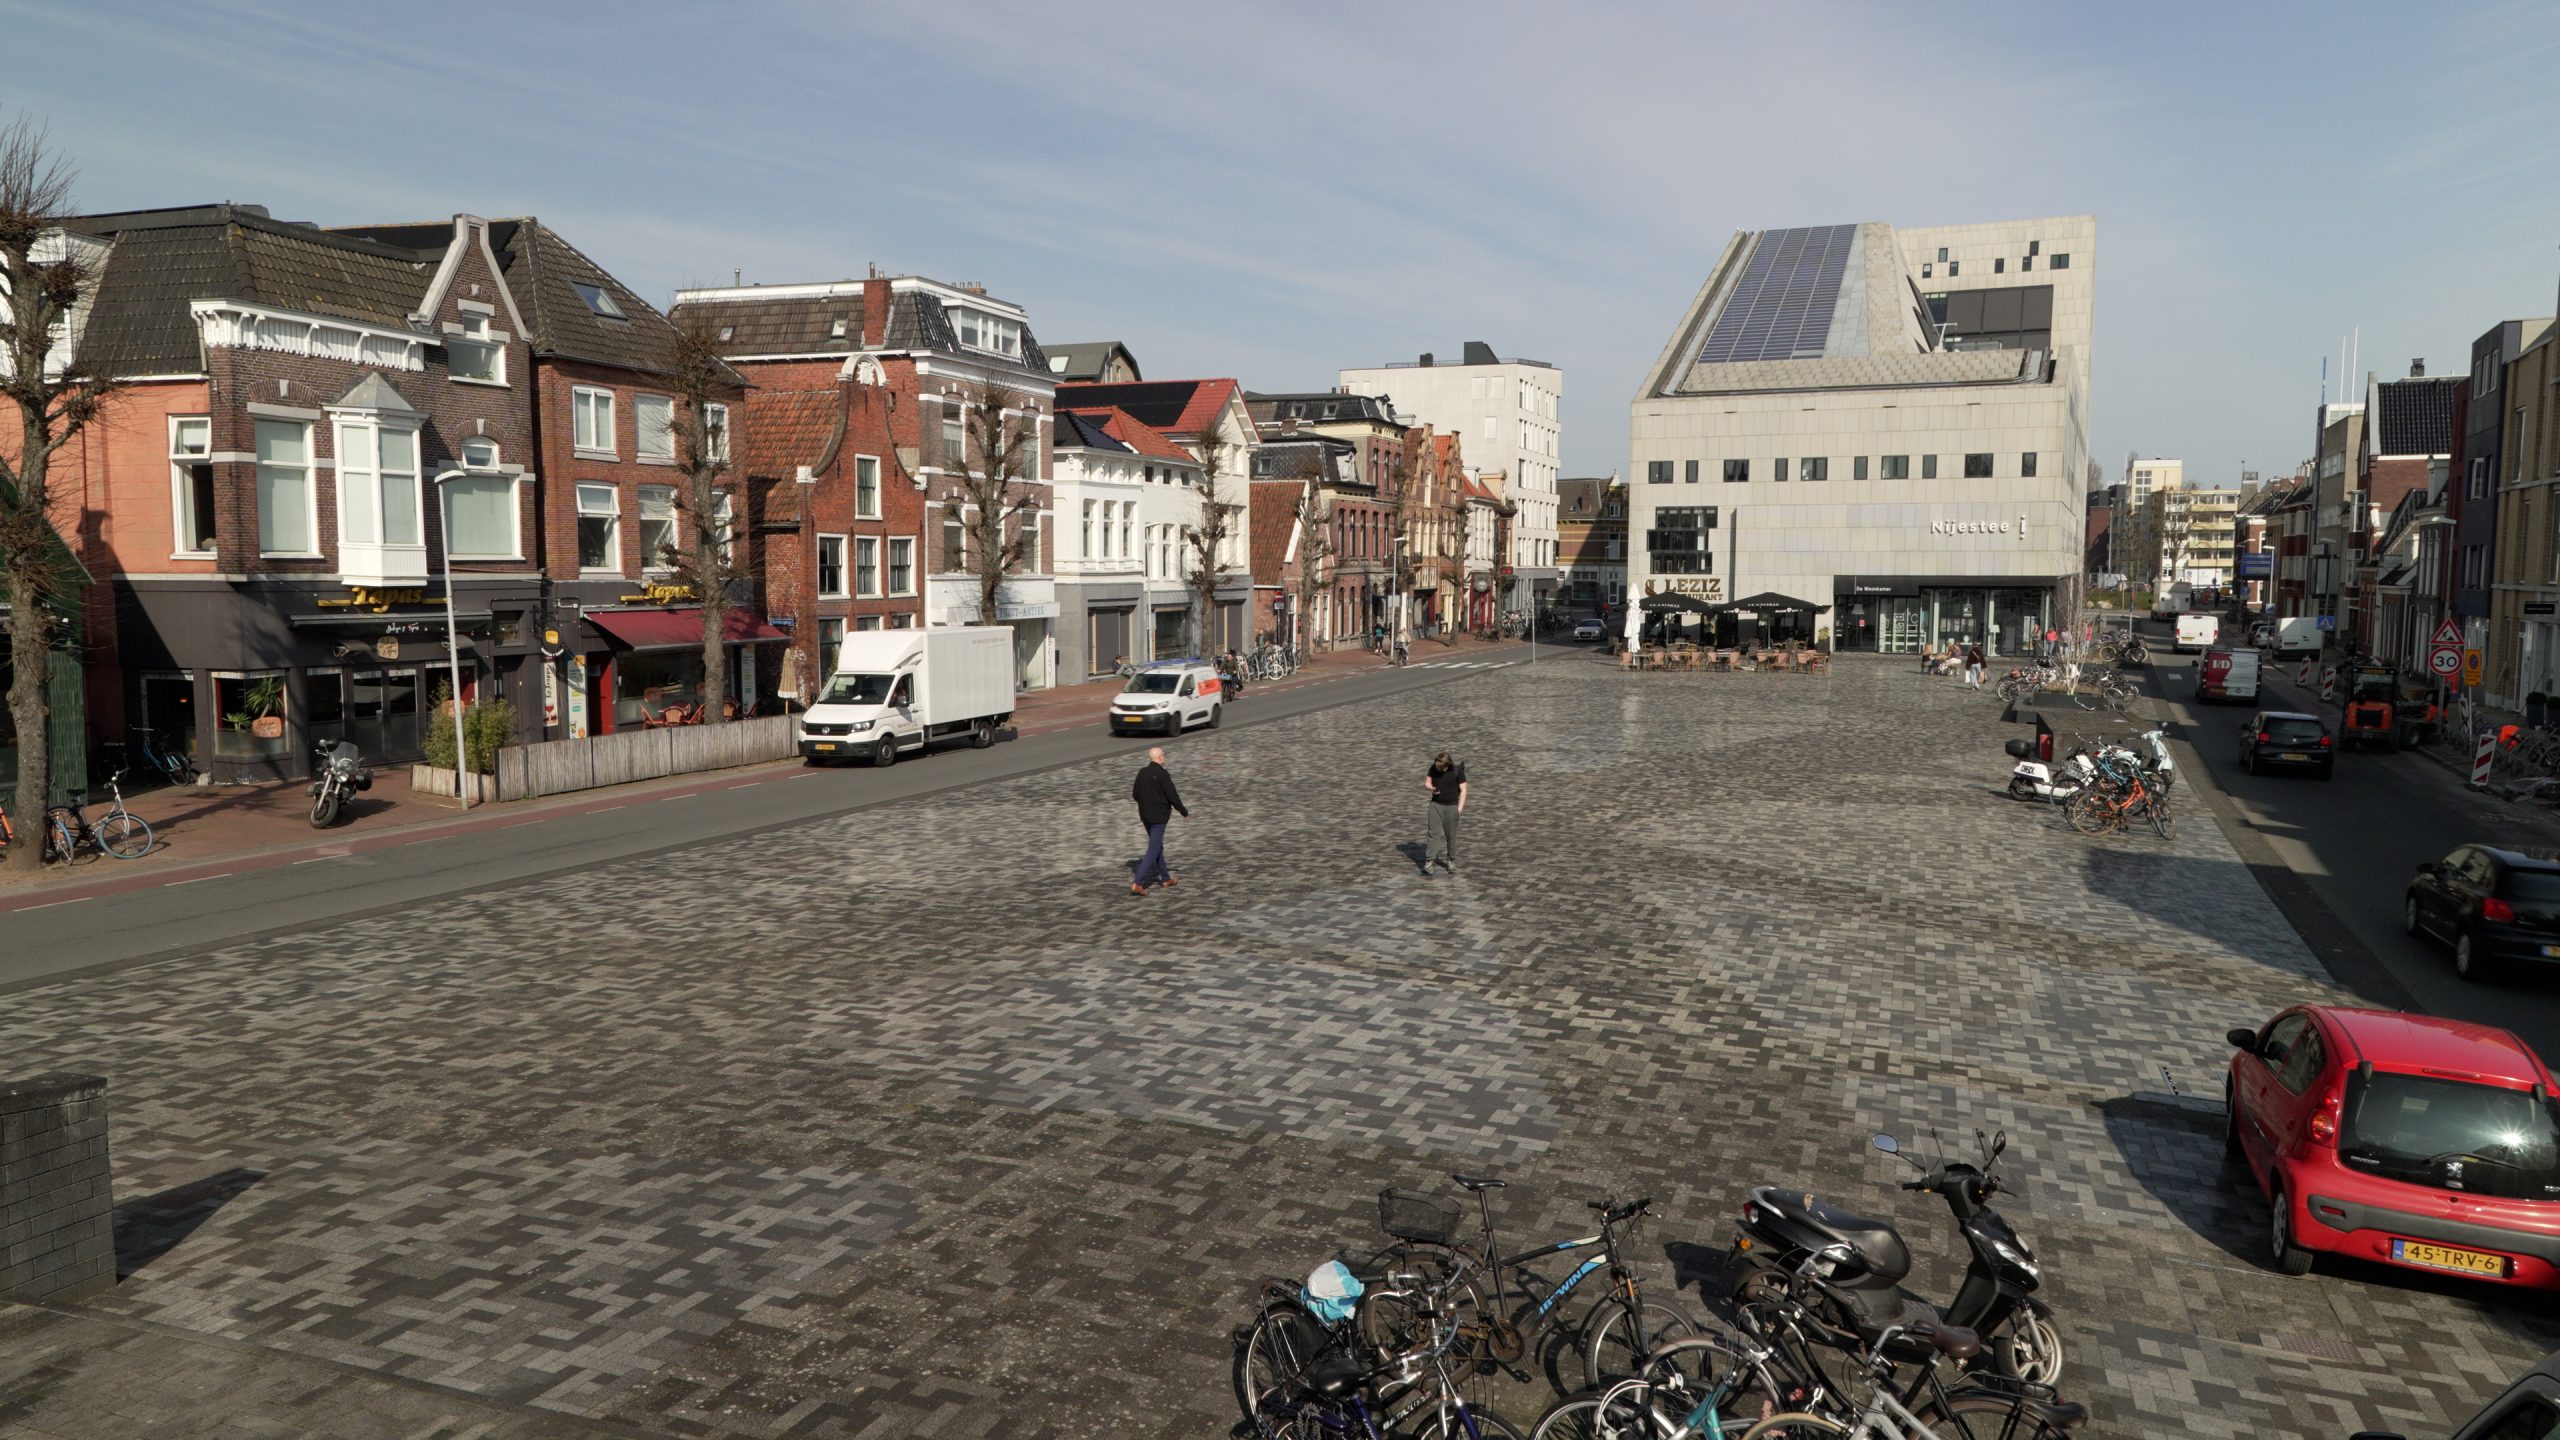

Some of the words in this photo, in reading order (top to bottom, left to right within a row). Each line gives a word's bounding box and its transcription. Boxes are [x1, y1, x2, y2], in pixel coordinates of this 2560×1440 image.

[1930, 520, 2009, 536] Nijestee
[1665, 579, 1721, 593] LEZIZ
[351, 587, 422, 613] Tapas
[2435, 656, 2457, 667] 30
[2410, 1246, 2496, 1270] 45-TRV-6
